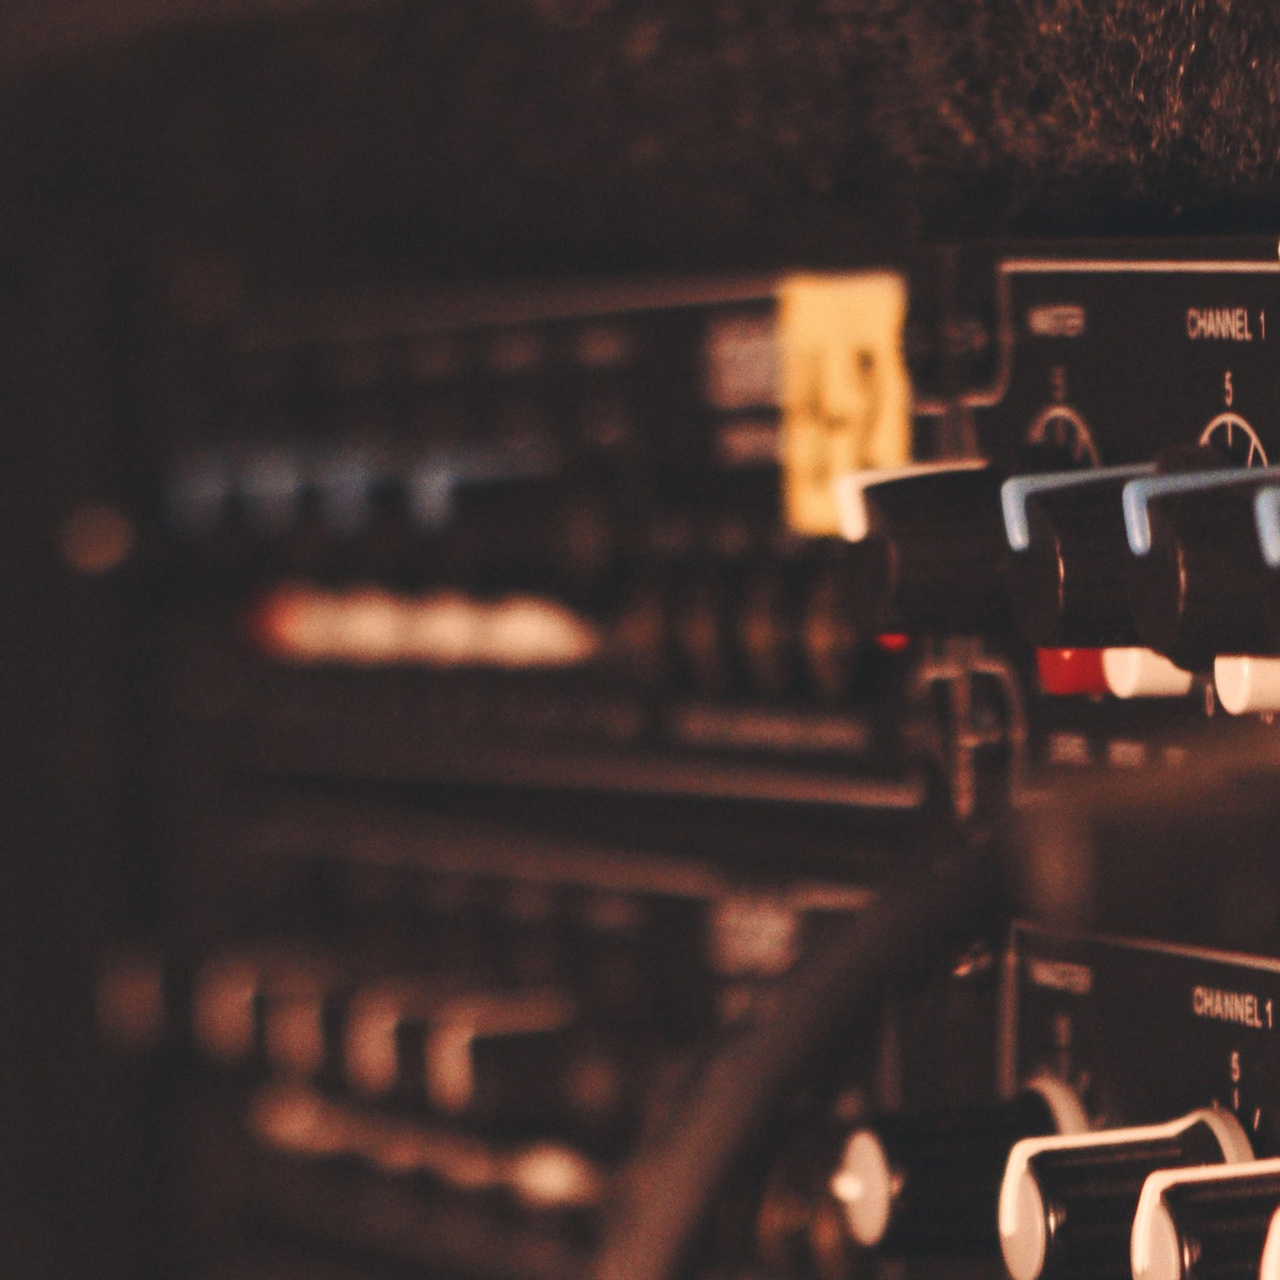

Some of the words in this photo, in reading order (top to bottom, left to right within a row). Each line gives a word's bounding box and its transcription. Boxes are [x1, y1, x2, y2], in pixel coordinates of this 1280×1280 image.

[1187, 308, 1252, 340] CHANNEL
[1259, 309, 1267, 340] 1
[1193, 985, 1263, 1029] CHANNEL
[1265, 998, 1273, 1030] 1
